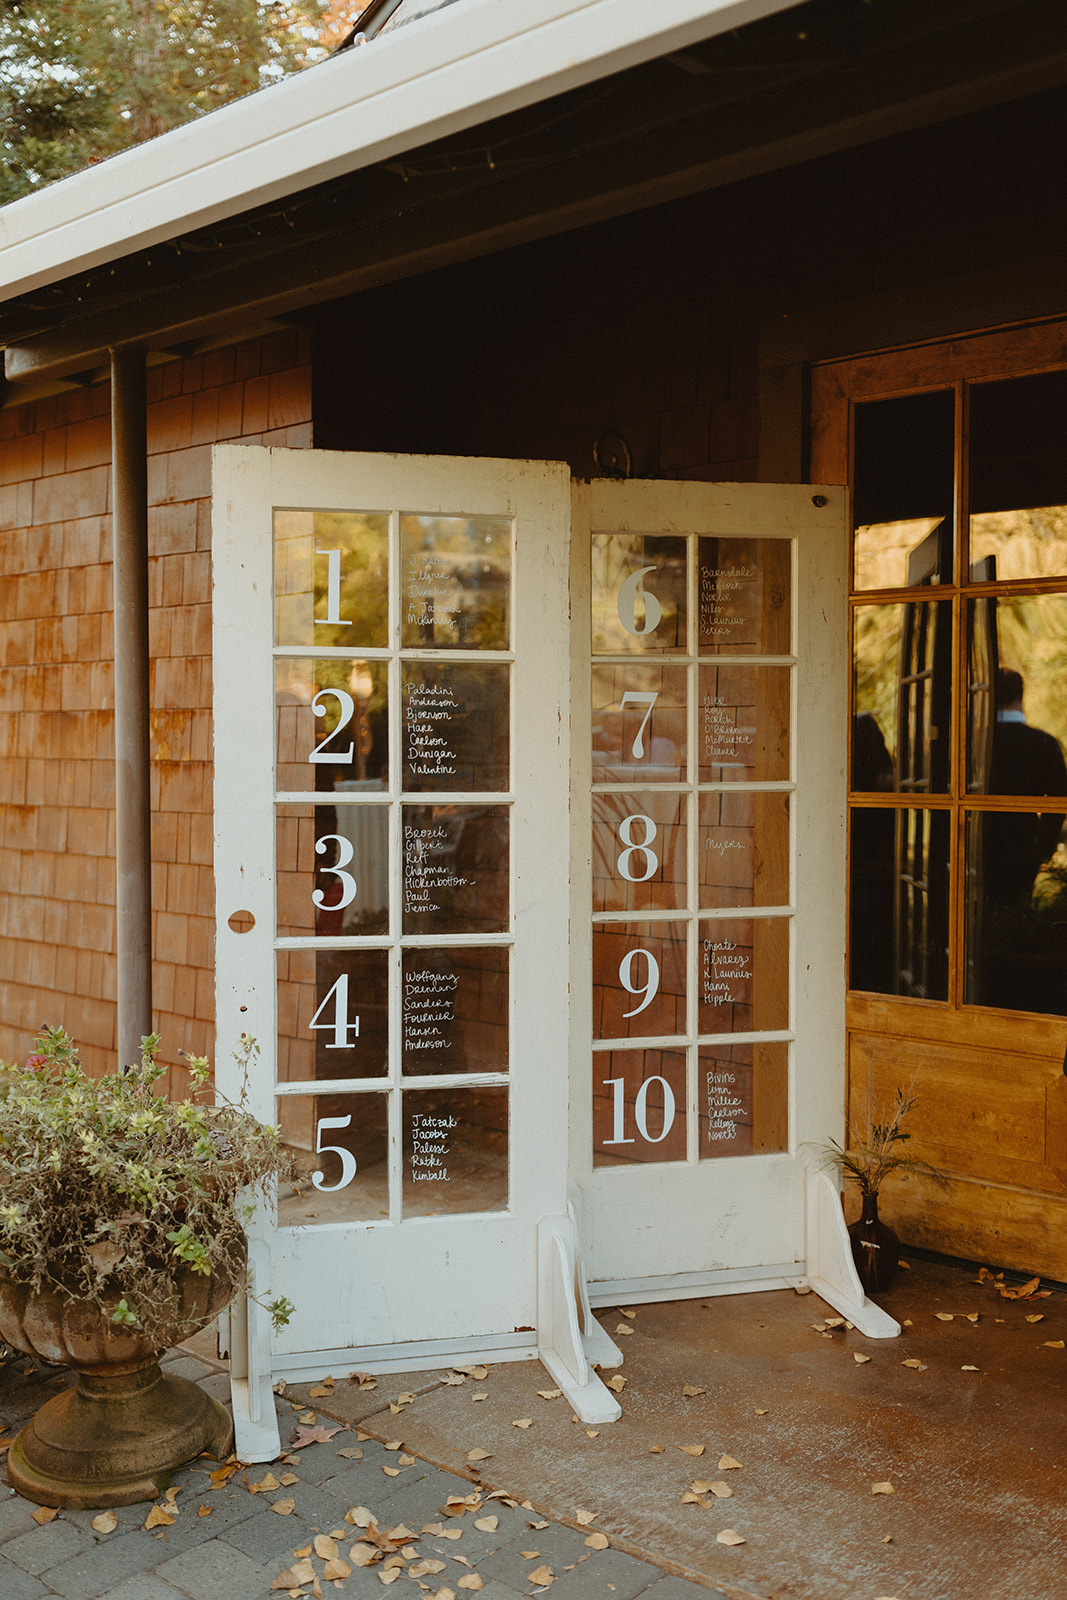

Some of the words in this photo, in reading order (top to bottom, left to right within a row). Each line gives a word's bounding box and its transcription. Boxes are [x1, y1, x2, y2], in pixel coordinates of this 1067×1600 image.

[700, 565, 754, 579] Barnsdale
[315, 550, 353, 625] 1
[408, 602, 416, 612] A
[617, 565, 662, 636] 6
[407, 613, 457, 630] McKinley
[700, 625, 731, 636] Peters
[404, 682, 454, 696] Paladini
[409, 696, 459, 707] Anderson
[406, 707, 452, 723] Bjornson
[308, 688, 354, 764] 2
[619, 690, 658, 759] 7
[704, 724, 742, 735] O'Brien
[407, 746, 457, 765] Dunigan
[409, 762, 457, 775] Valentine
[404, 825, 448, 839] Brozek
[405, 838, 444, 852] Gilbert
[617, 814, 658, 882] 8
[706, 838, 745, 857] Myers
[312, 834, 357, 911] 3
[405, 864, 453, 879] Chapman
[405, 876, 477, 890] Hickenbottom
[405, 888, 431, 902] Paul
[703, 951, 750, 968] Alvarez
[405, 970, 460, 986] Wolfgang
[619, 949, 659, 1018] 9
[403, 996, 453, 1011] Sanders
[704, 991, 736, 1007] Hipple
[308, 973, 360, 1049] 4
[403, 1011, 455, 1024] Fournier
[405, 1038, 452, 1051] Anderson
[706, 1071, 736, 1084] Bivins
[707, 1095, 742, 1107] Miller
[602, 1075, 675, 1144] 10
[708, 1106, 748, 1119] Carlson
[411, 1113, 458, 1128] Jatczak
[411, 1128, 449, 1140] Jacobs
[707, 1130, 737, 1142] North
[312, 1114, 357, 1192] 5
[410, 1153, 443, 1168] Ratke
[411, 1167, 451, 1183] Kimball
